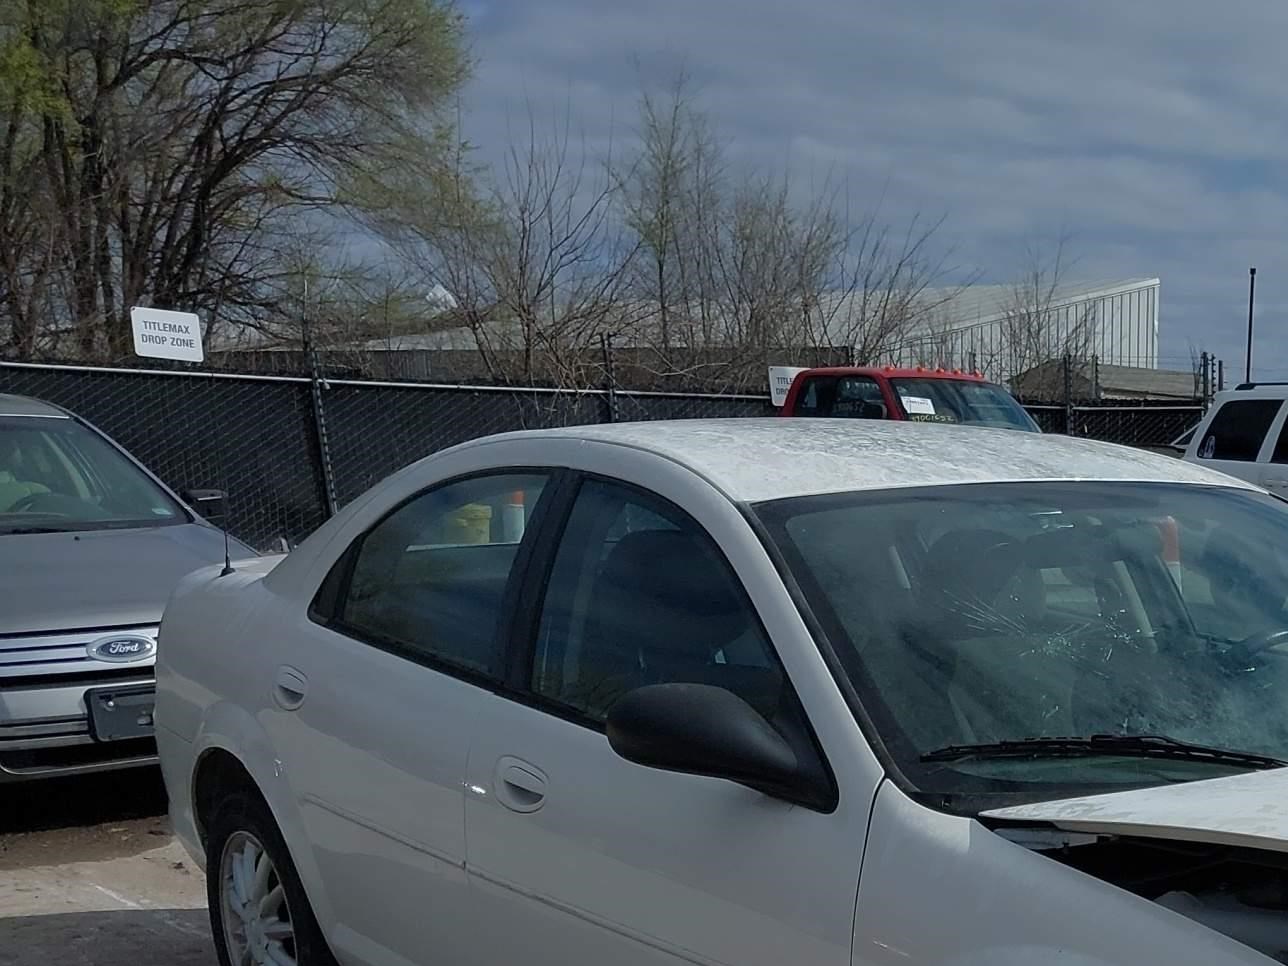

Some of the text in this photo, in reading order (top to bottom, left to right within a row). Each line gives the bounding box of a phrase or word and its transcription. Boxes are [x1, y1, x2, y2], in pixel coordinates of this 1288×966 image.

[143, 320, 190, 335] TITLEMAX
[141, 333, 196, 349] DROP ZONE
[109, 641, 139, 654] Ford
